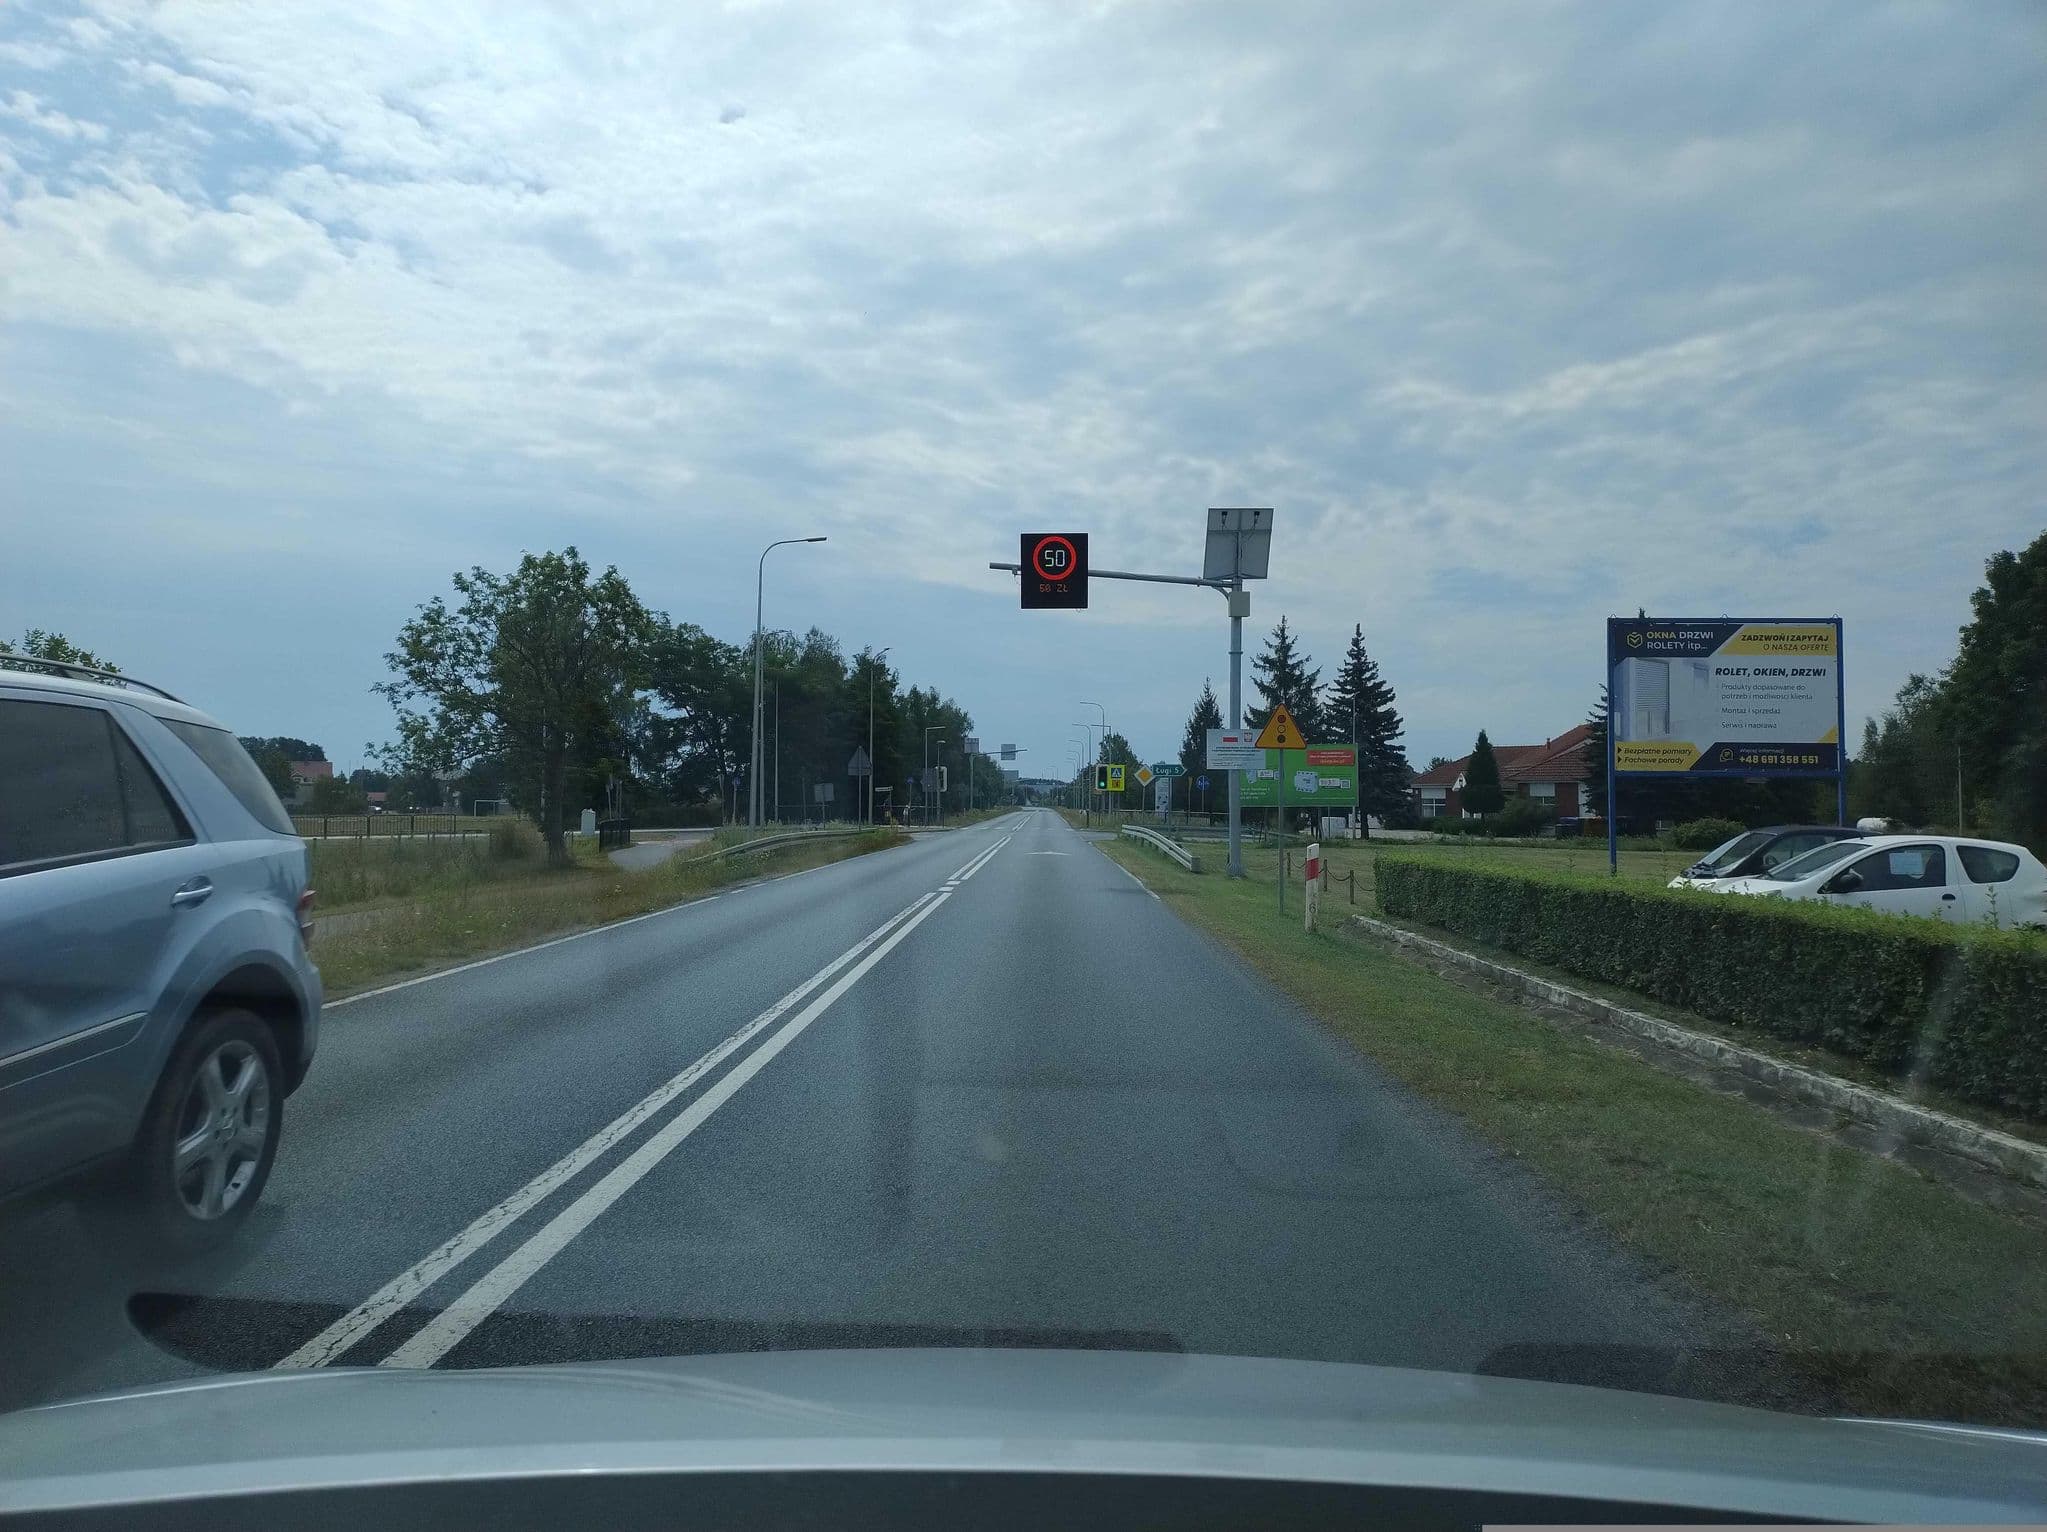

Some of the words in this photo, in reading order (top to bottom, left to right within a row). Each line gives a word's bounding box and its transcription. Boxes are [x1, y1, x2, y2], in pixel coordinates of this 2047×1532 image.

[1045, 550, 1066, 567] 50
[1646, 631, 1677, 639] OKNA
[1679, 631, 1714, 639] DRZWI
[1741, 633, 1785, 641] ZADZWOŃ
[1790, 634, 1829, 642] ZAPYTAJ
[1647, 641, 1685, 649] ROLETY
[1715, 668, 1751, 677] ROLET,
[1753, 668, 1789, 677] OKIEN,
[1791, 668, 1826, 677] DRZWI
[1721, 683, 1751, 691] Produkty
[1657, 757, 1685, 765] porady
[1739, 755, 1759, 764] +48
[1779, 755, 1799, 764] 358
[1801, 755, 1818, 764] 551
